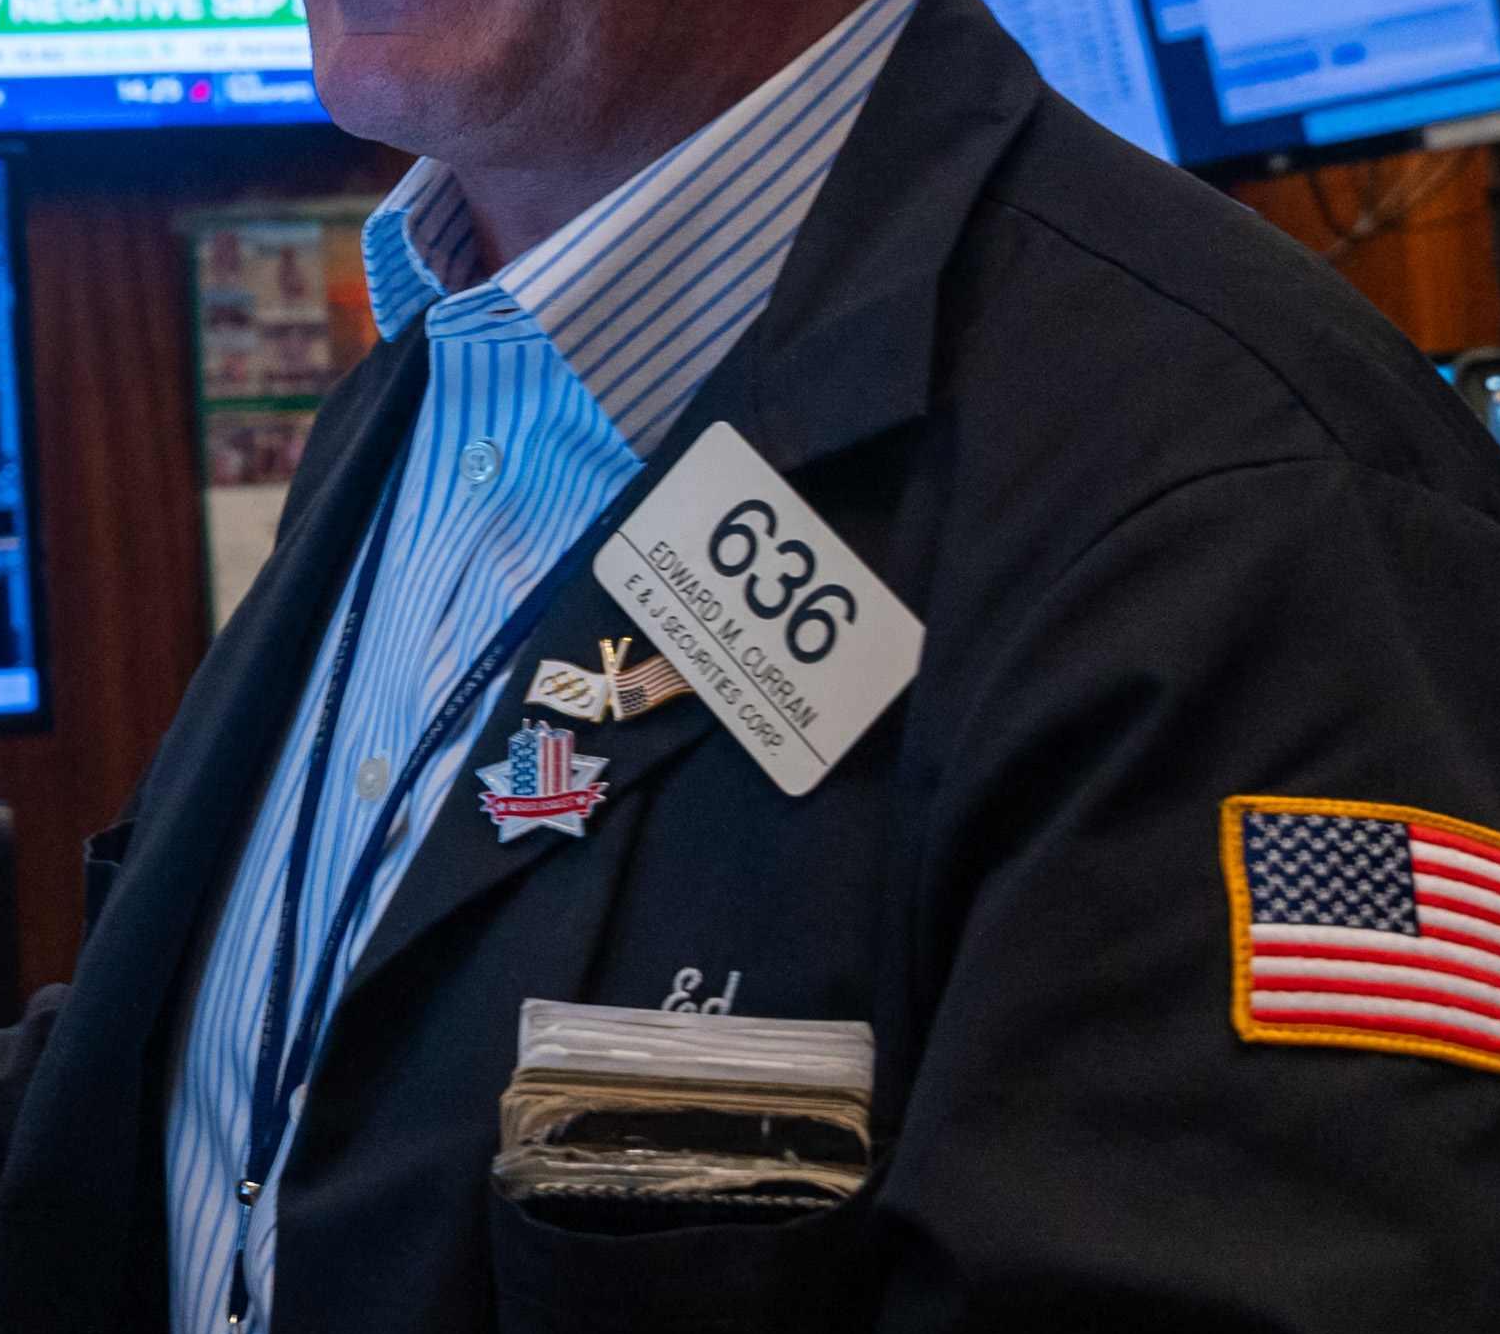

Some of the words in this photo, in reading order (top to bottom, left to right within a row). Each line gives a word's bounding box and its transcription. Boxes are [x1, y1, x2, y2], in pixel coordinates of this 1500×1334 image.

[624, 574, 642, 591] E
[636, 588, 653, 607] &
[660, 615, 742, 706] SECURITIES
[737, 703, 785, 757] CORP.
[648, 541, 724, 622] EDWARD
[716, 618, 744, 651] M.
[741, 646, 818, 729] CURRAN
[708, 499, 857, 664] 636
